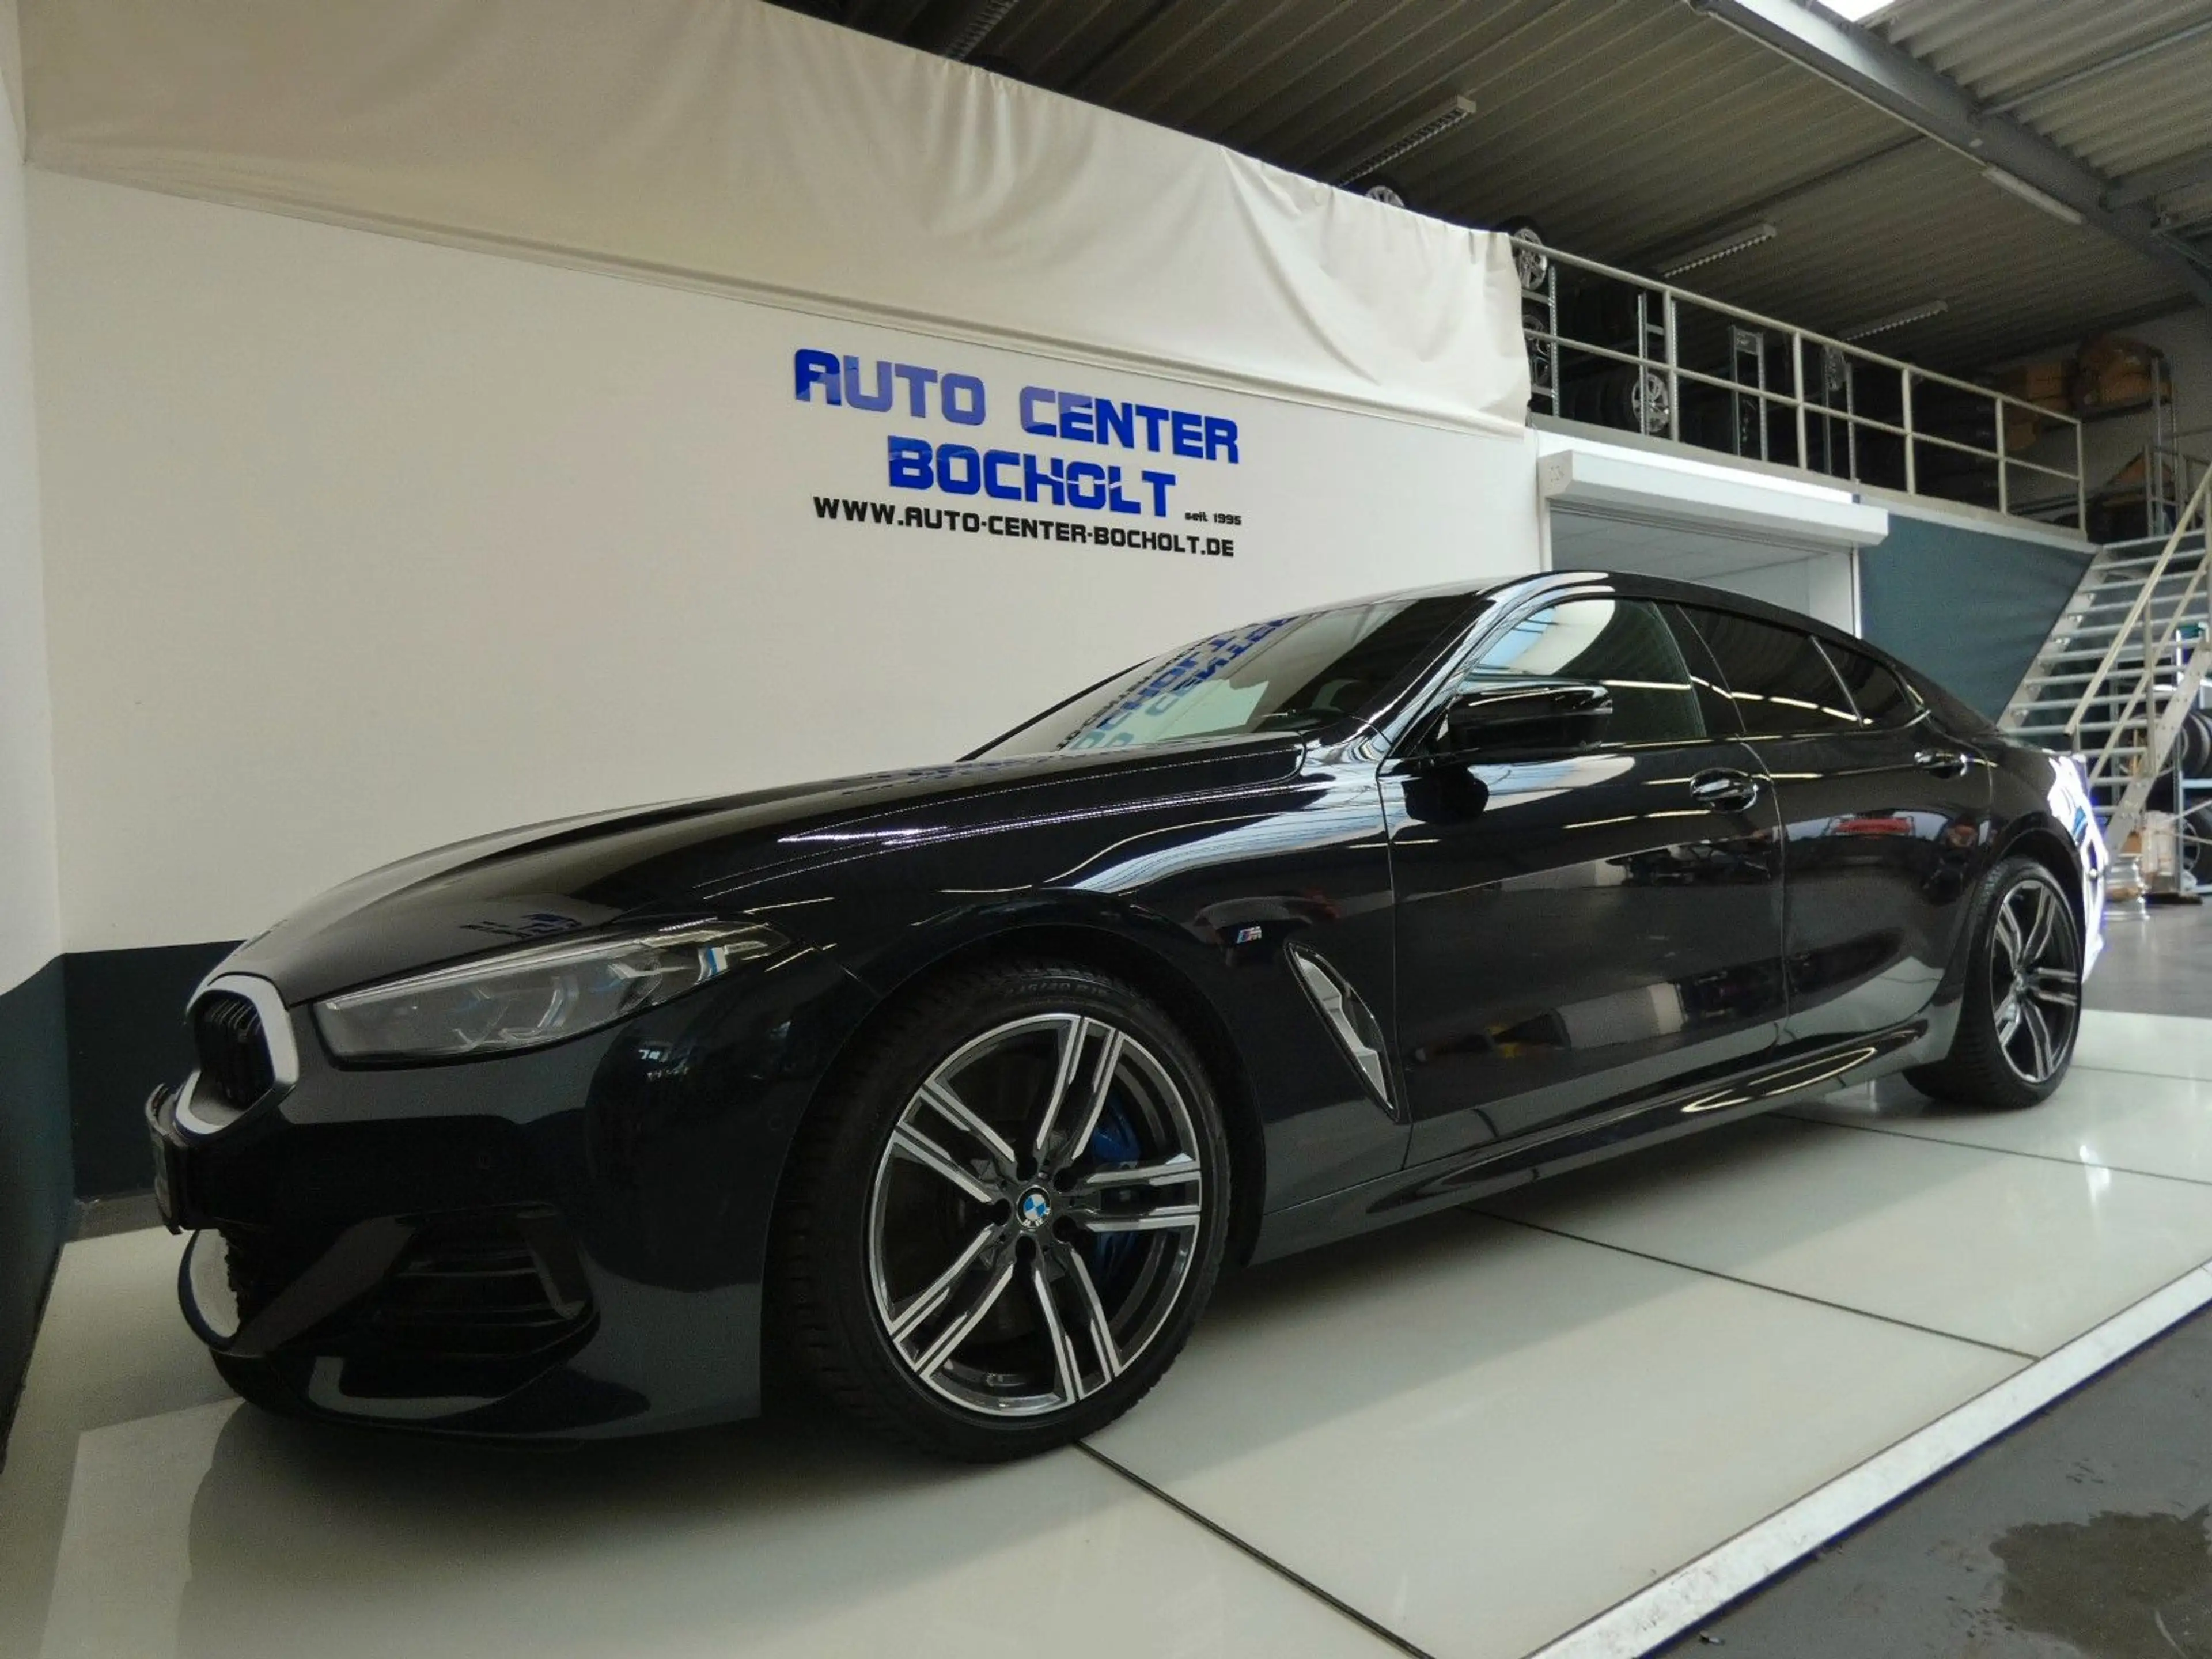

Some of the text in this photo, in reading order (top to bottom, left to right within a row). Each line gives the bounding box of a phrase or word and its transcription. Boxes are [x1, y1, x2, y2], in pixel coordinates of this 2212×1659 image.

[795, 348, 1240, 464] AUTO CENTER
[888, 434, 1177, 517] BOCHOLT
[812, 495, 1234, 558] WWW.AUTO-CENTER-BOCHOLT.DE
[1213, 512, 1242, 526] 1995
